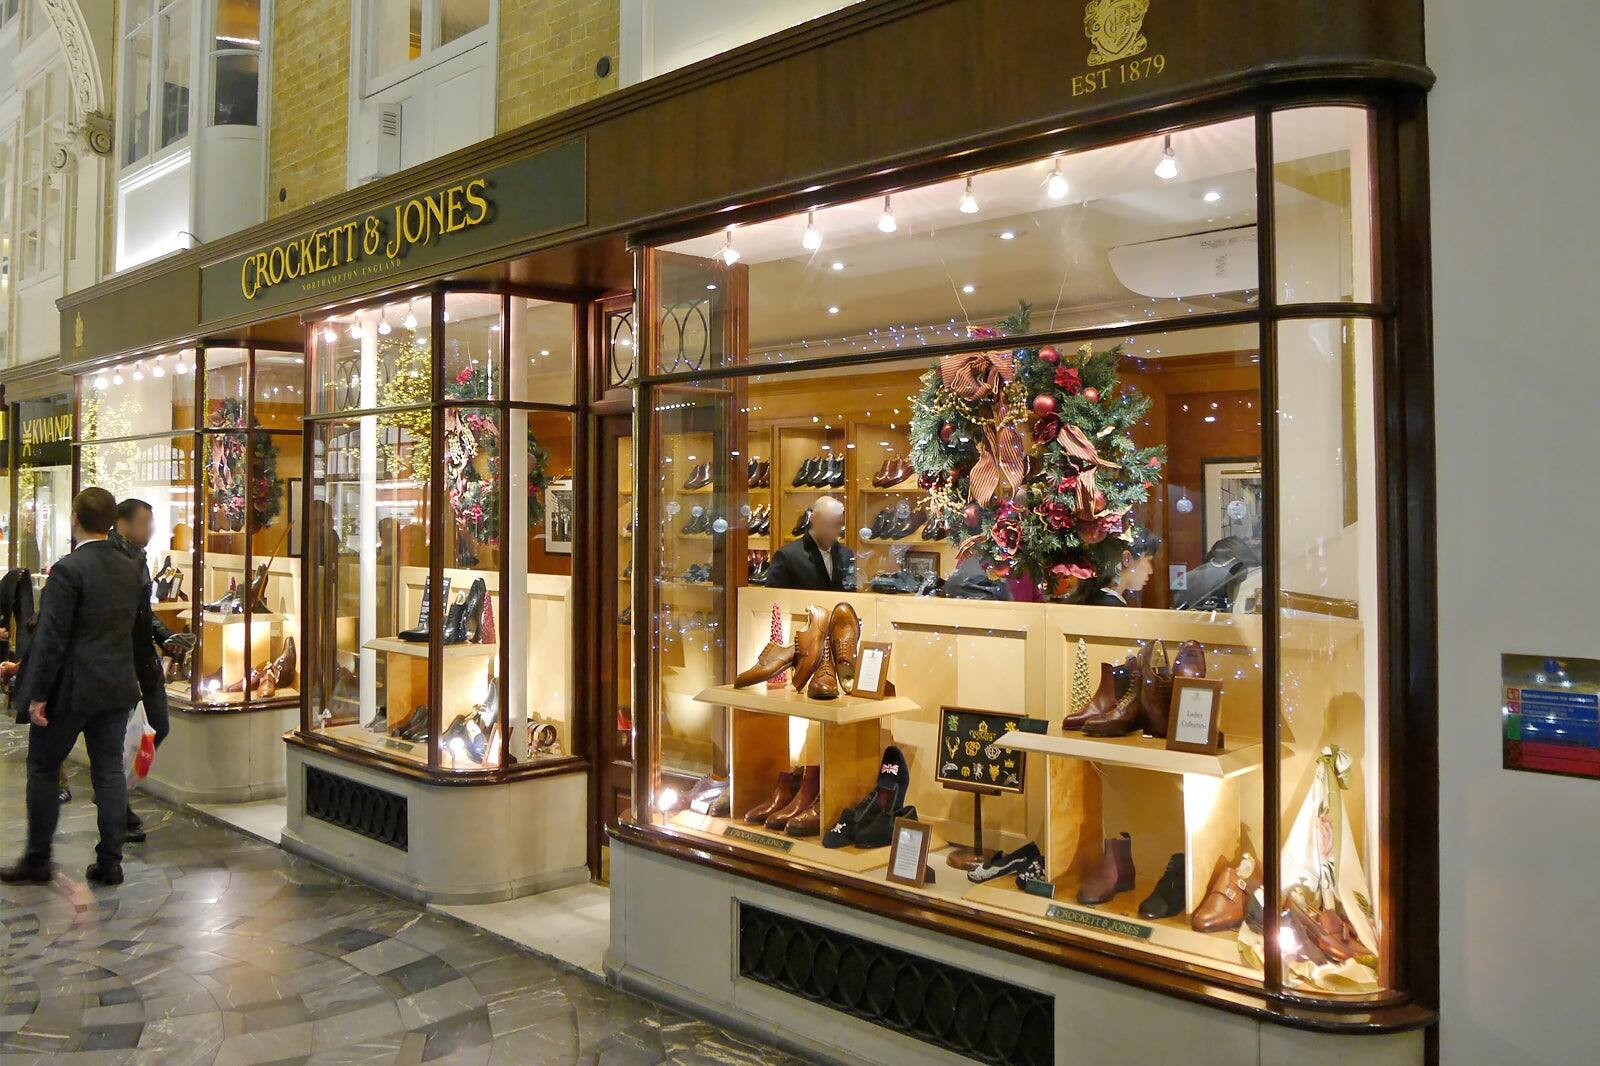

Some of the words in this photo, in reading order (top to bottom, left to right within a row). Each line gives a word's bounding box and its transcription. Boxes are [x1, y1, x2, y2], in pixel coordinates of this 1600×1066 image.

[1071, 68, 1111, 97] EST
[1120, 54, 1165, 84] 1879
[241, 221, 358, 300] CROCKETT
[363, 215, 380, 256] &
[386, 178, 488, 259] JONES
[302, 270, 357, 291] NORTHAMPTON
[362, 260, 401, 275] ENGLAND
[1056, 909, 1100, 927] CROCKETT
[1110, 919, 1140, 936] JONES
